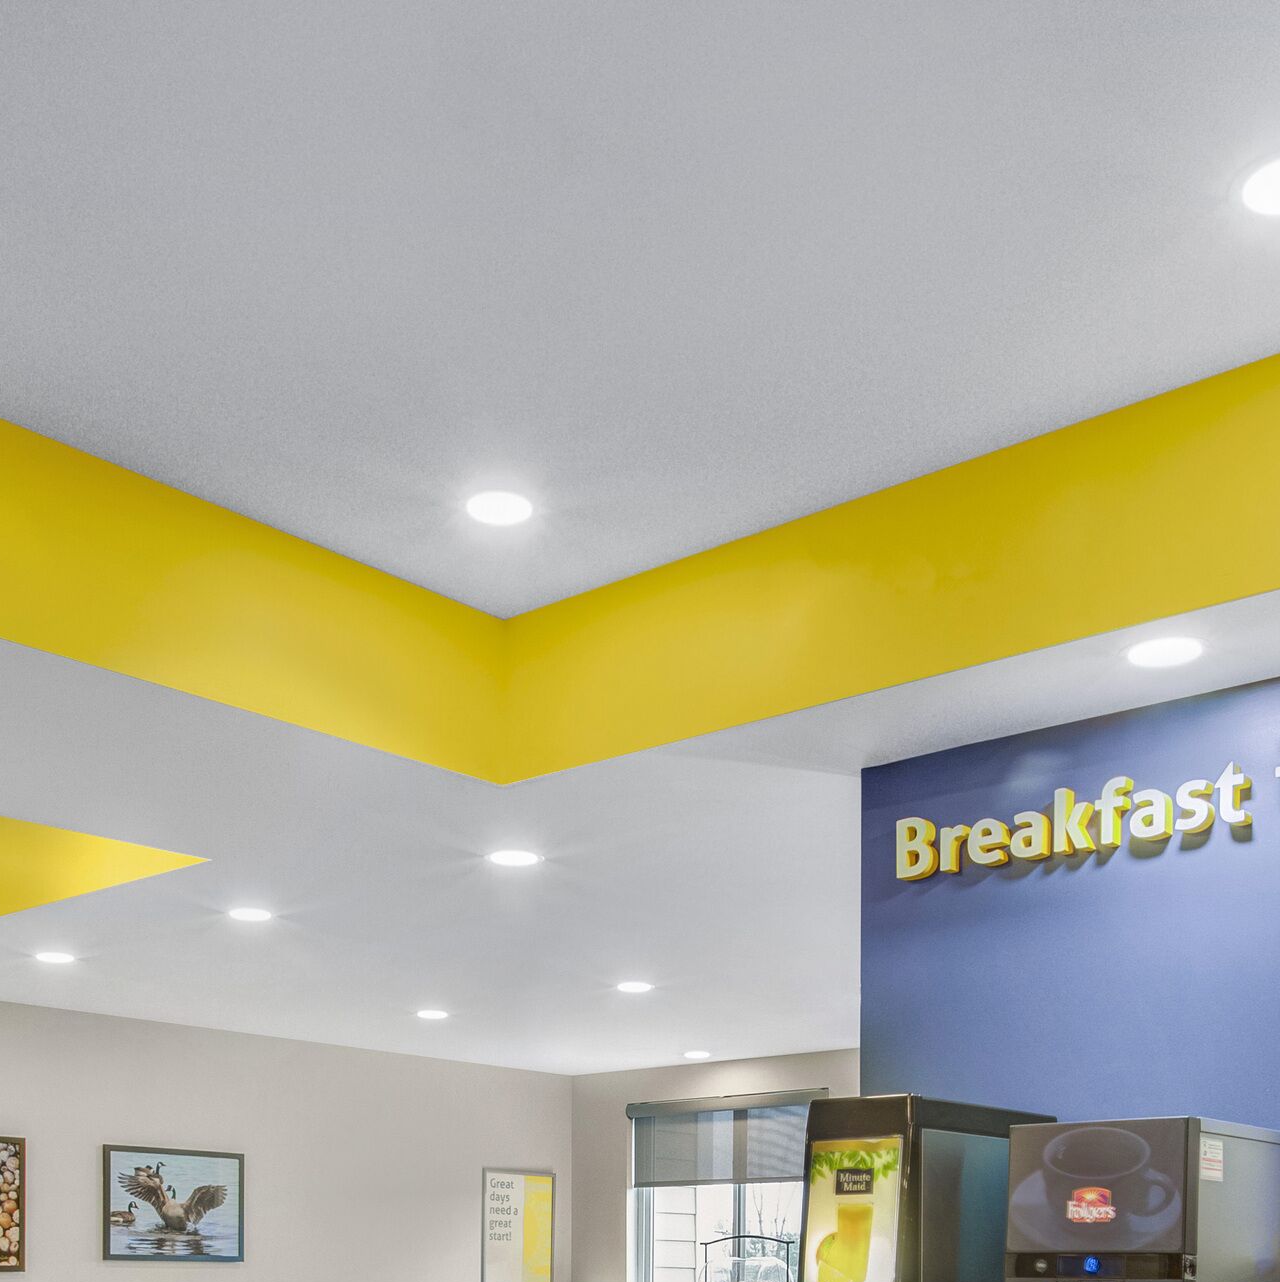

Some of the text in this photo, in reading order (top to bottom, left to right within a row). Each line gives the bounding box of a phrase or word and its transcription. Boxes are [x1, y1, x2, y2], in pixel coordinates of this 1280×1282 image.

[896, 760, 1252, 881] Breakfast
[839, 1172, 871, 1183] Minute
[489, 1178, 515, 1190] Great
[843, 1182, 866, 1192] Maid
[489, 1191, 511, 1204] days
[489, 1206, 519, 1216] need a
[1066, 1199, 1117, 1221] Folgers
[489, 1219, 512, 1231] great
[489, 1232, 512, 1241] start!
